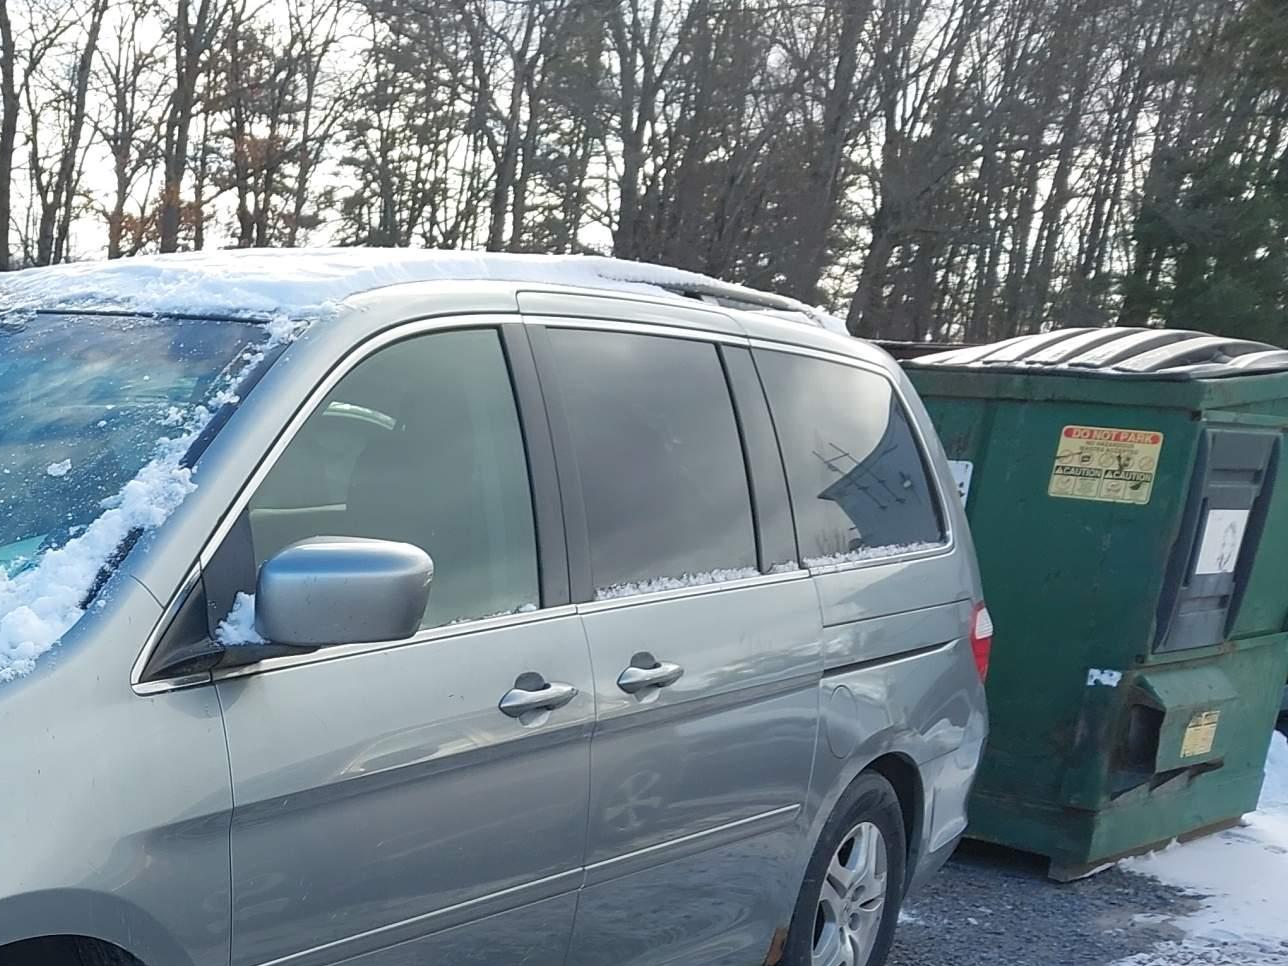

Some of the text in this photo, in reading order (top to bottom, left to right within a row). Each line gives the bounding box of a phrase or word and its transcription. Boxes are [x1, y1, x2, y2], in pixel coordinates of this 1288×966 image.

[1072, 428, 1152, 444] DO NOT PARK
[1063, 467, 1101, 478] CAUTION
[1113, 471, 1152, 481] CAUTION
